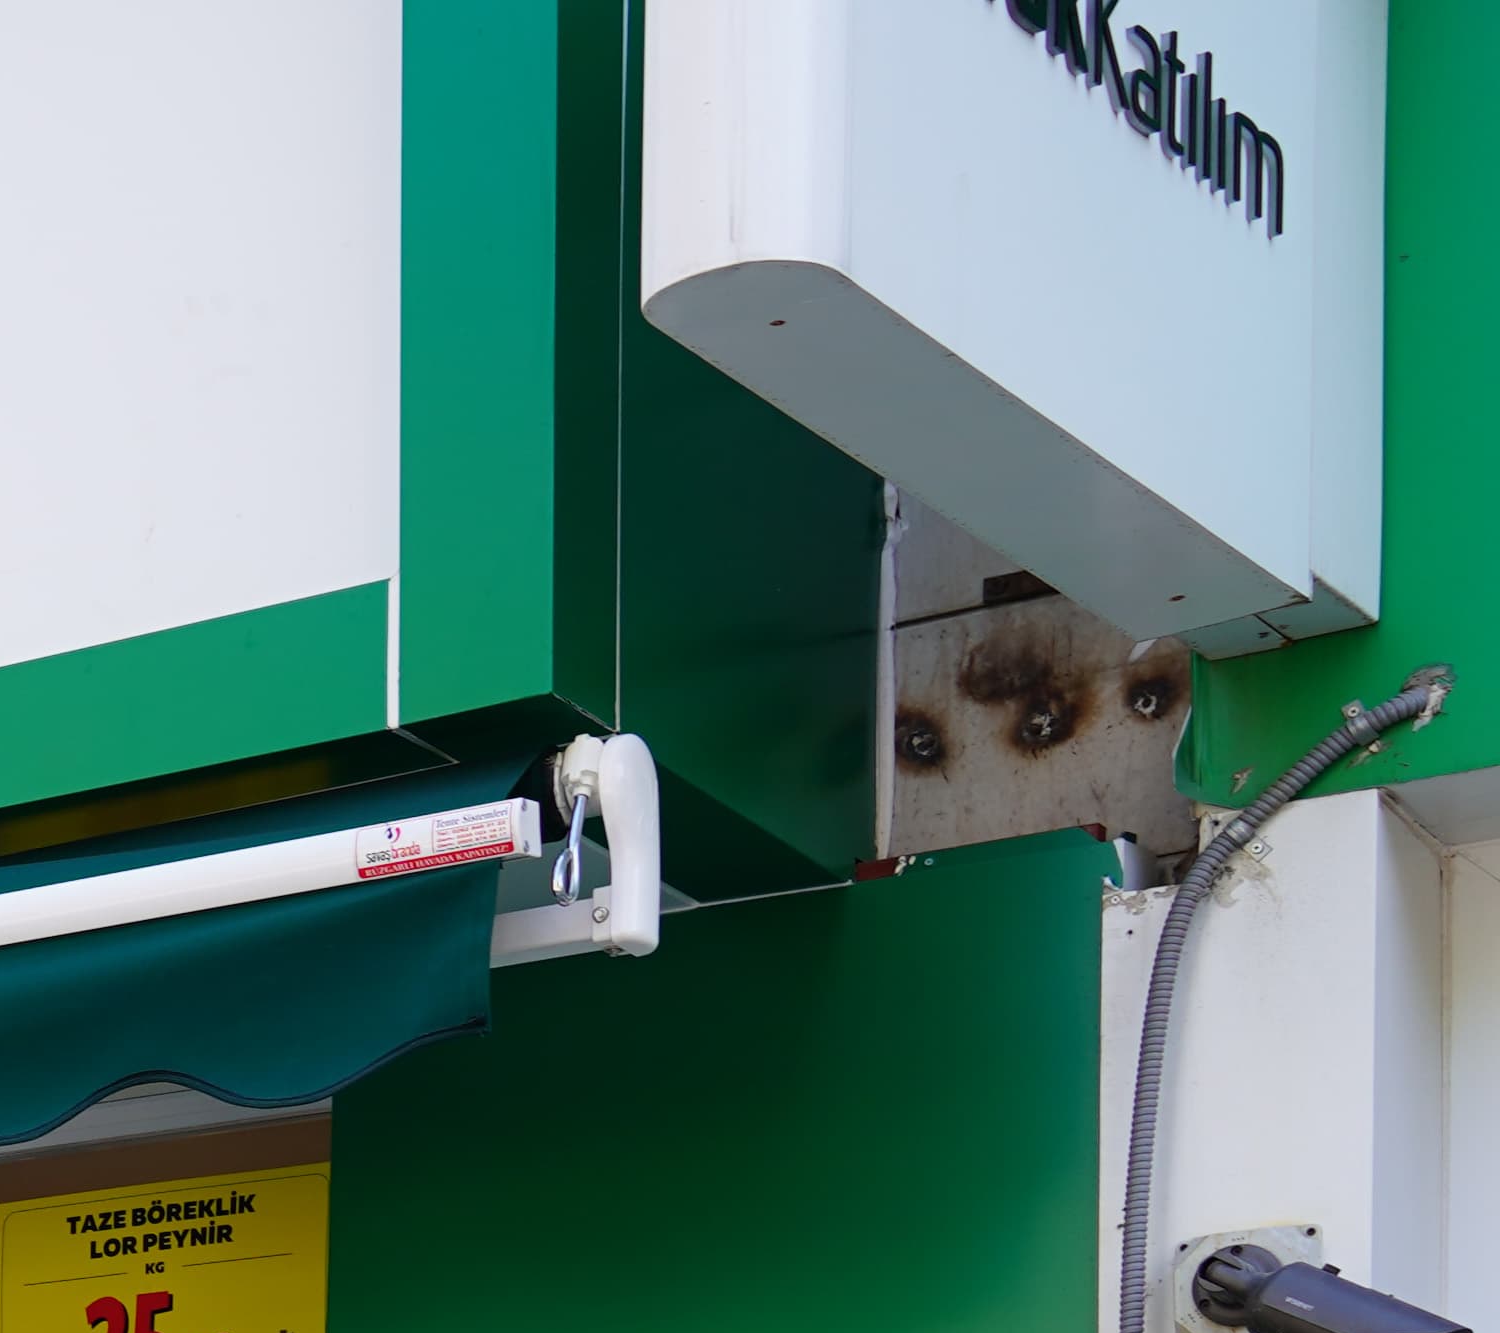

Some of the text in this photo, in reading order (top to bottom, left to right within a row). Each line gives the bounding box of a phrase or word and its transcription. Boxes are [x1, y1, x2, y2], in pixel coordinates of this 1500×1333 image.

[67, 1191, 257, 1235] TAZE BÖREKLİK
[89, 1219, 234, 1260] LOR PEYNİR
[144, 1261, 165, 1275] KG
